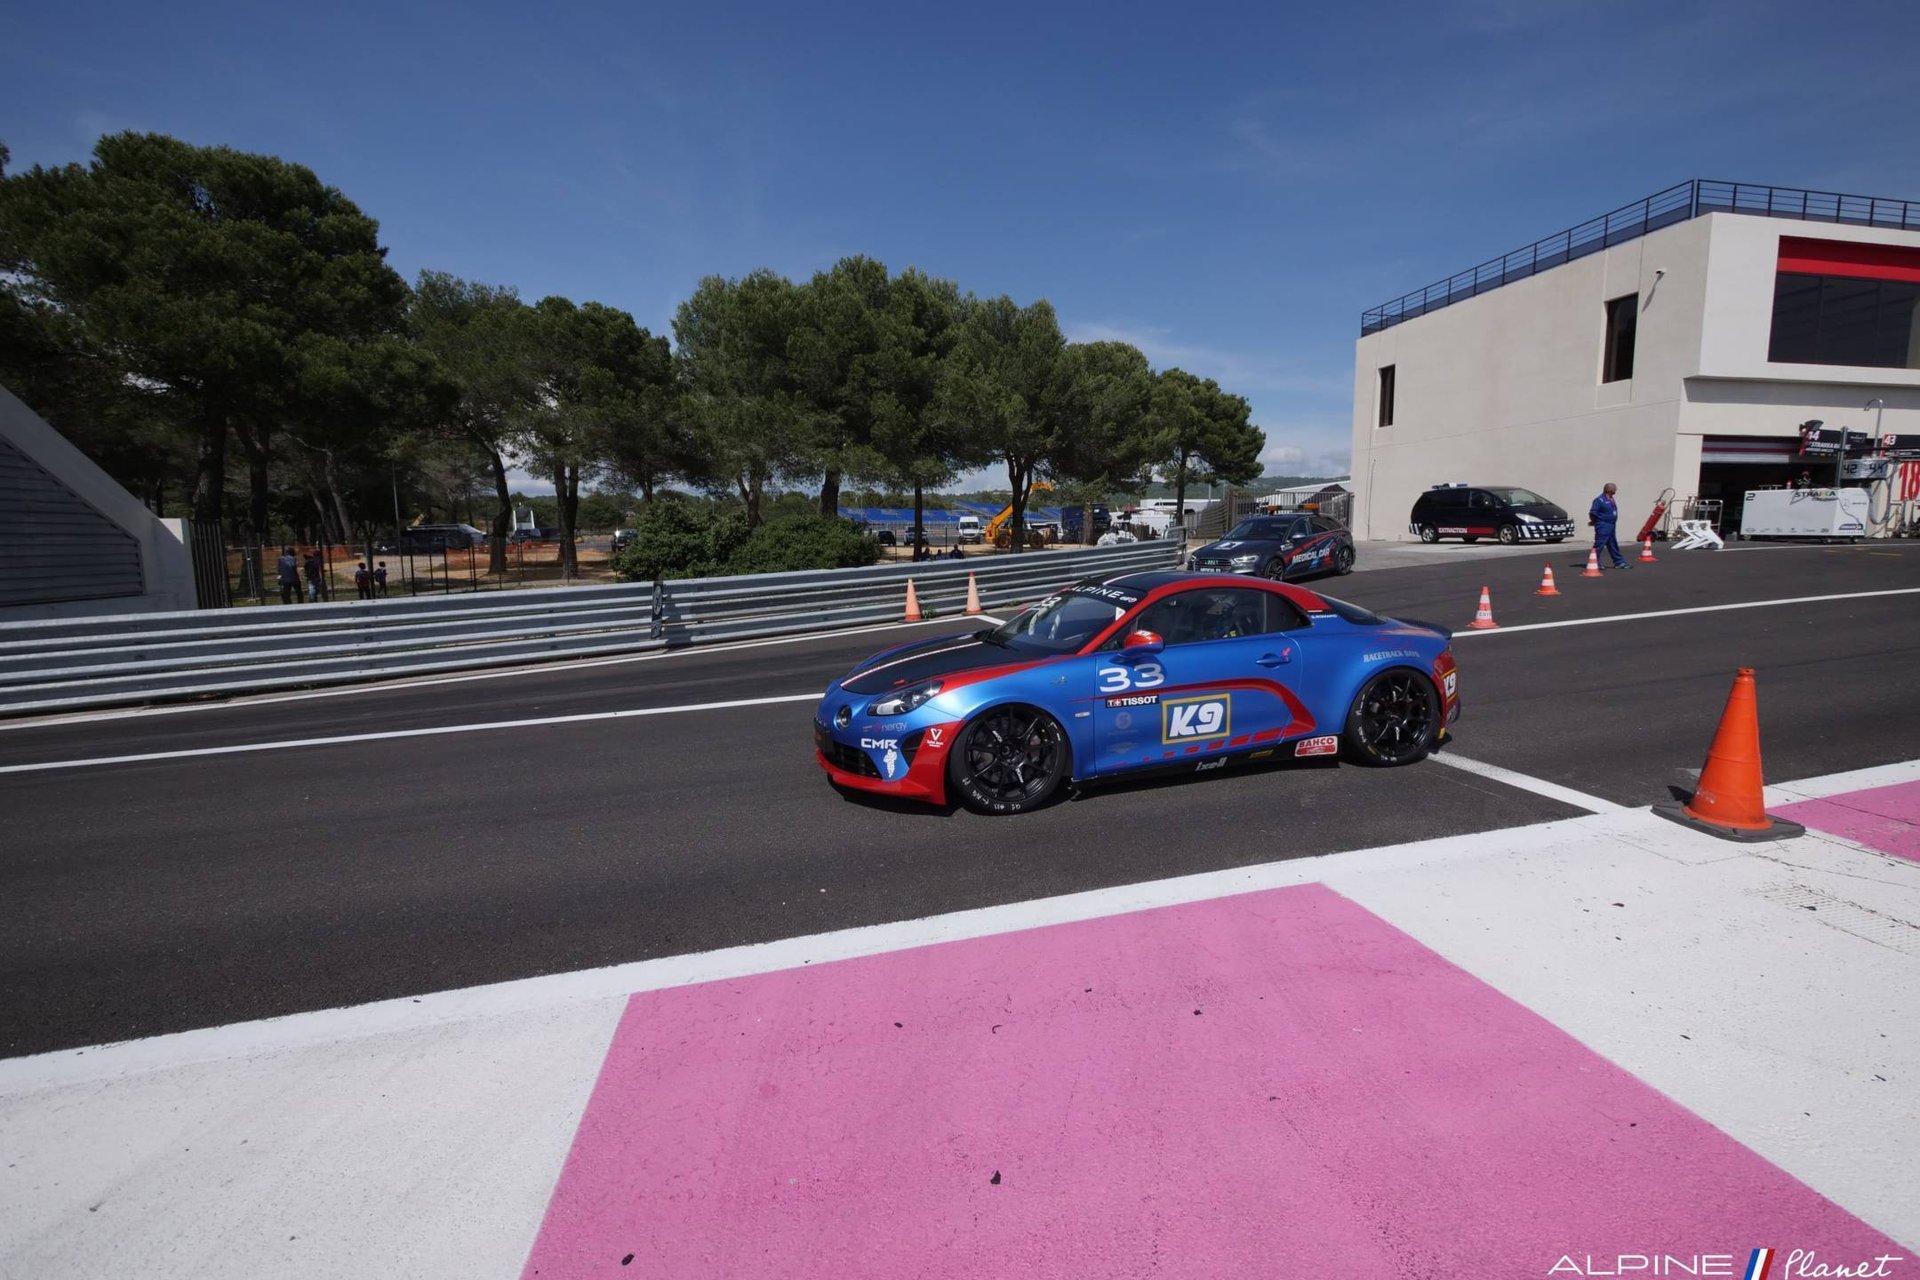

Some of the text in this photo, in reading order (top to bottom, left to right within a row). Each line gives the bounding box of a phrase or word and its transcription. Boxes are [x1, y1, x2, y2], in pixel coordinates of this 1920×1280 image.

[1745, 492, 1756, 501] 2
[1291, 550, 1317, 565] MEDICAL
[1069, 585, 1124, 599] ALPINE
[1099, 663, 1165, 692] 33
[1121, 695, 1158, 706] TISSOT
[1169, 702, 1224, 737] K9
[860, 738, 898, 749] CMR
